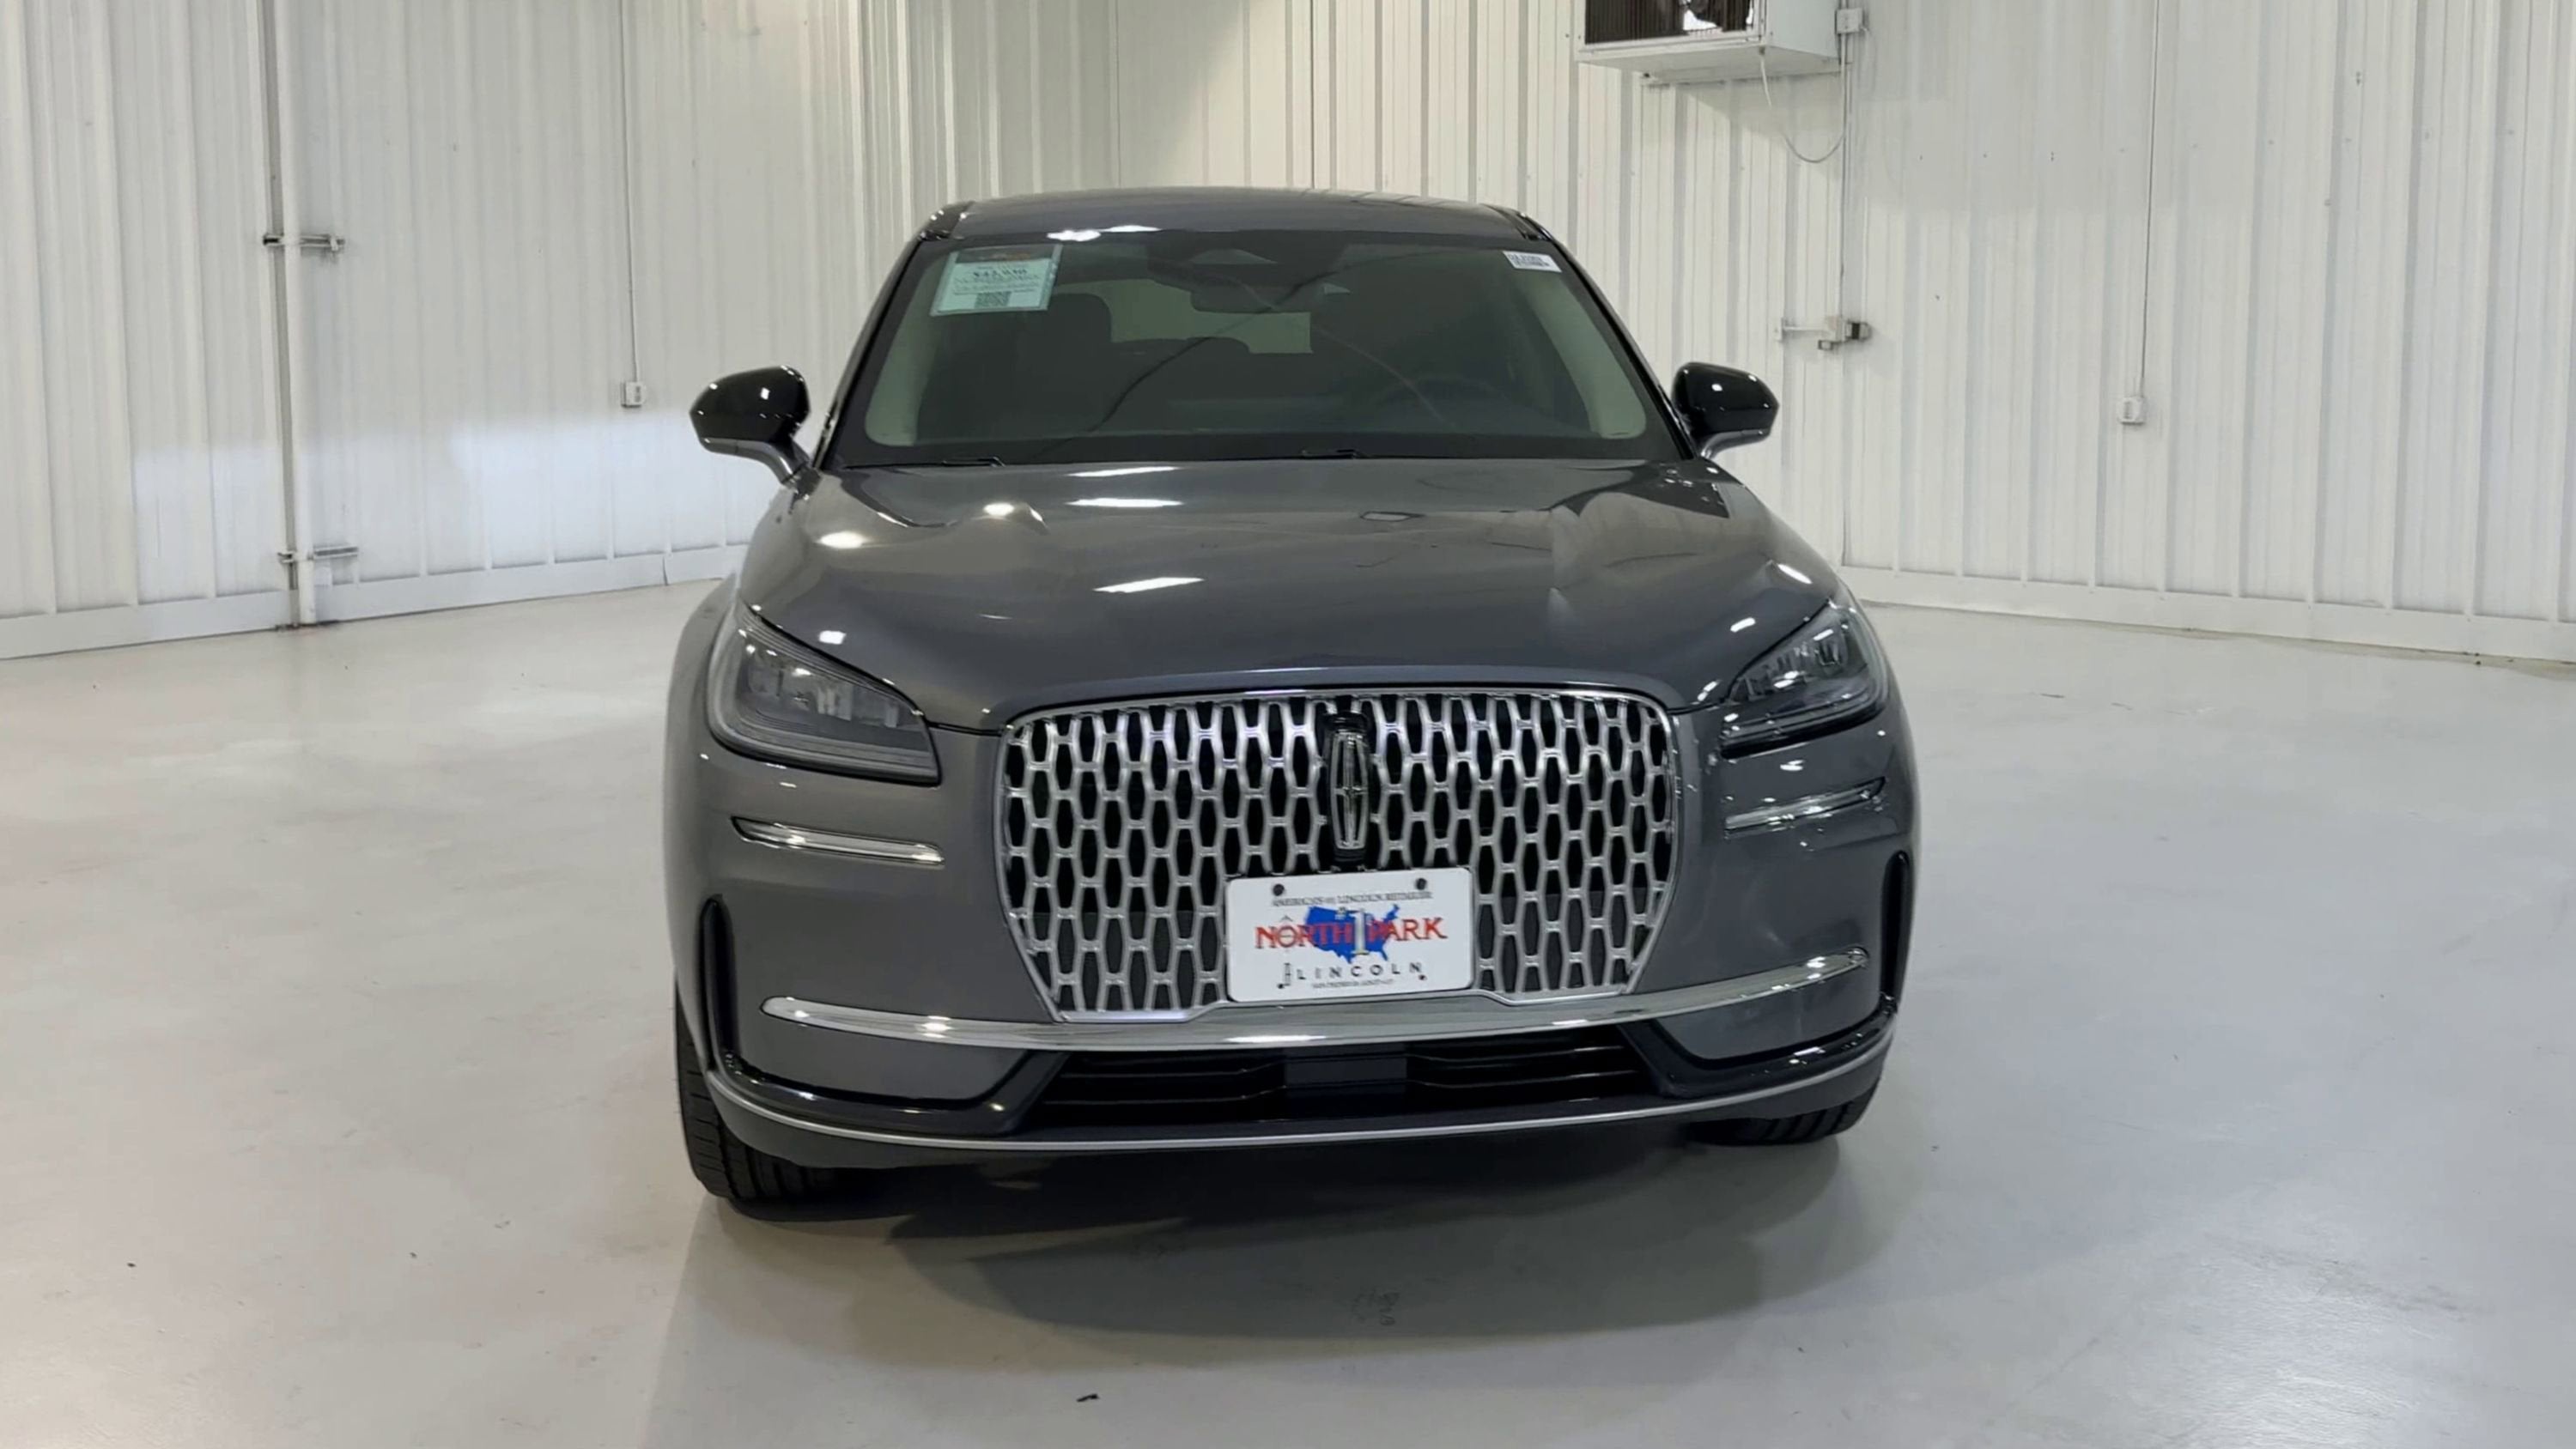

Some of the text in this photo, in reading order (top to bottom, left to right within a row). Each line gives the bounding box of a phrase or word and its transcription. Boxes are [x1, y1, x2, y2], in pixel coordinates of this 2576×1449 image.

[1255, 917, 1449, 949] NORTH PARK
[1296, 962, 1422, 979] LINCOLN
